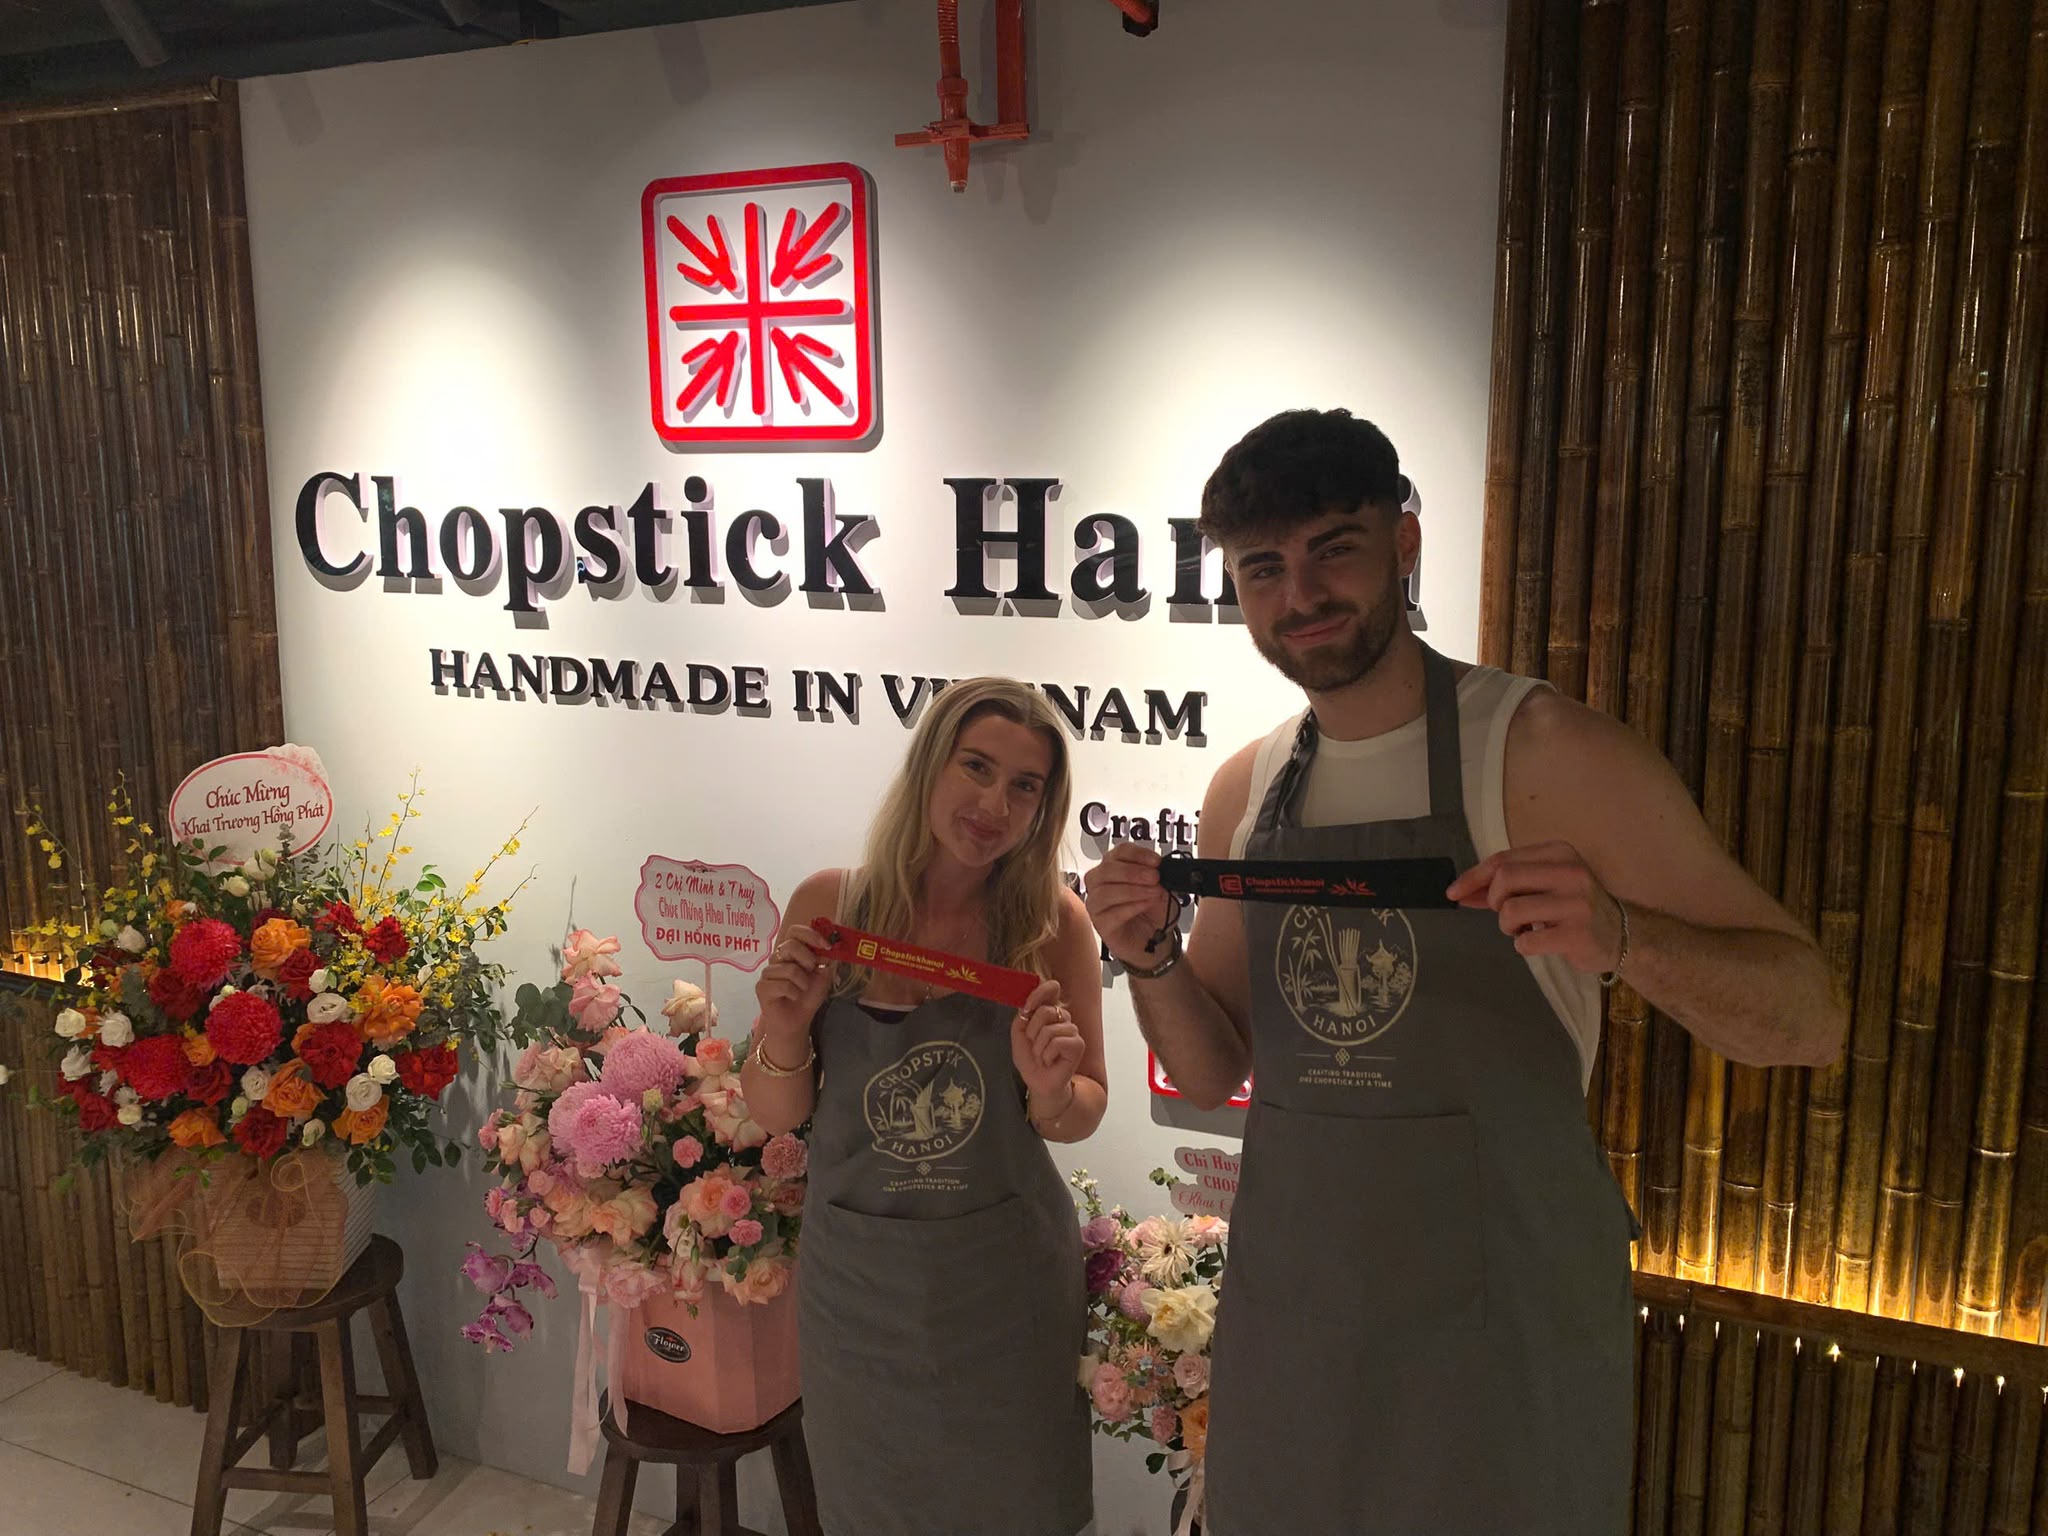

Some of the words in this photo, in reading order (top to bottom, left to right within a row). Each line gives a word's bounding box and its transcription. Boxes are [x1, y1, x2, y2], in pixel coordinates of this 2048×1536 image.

[295, 471, 881, 612] Chopstick
[429, 648, 769, 709] HANDMADE
[793, 669, 860, 716] IN
[880, 673, 1207, 738] VNAM
[205, 785, 241, 809] Chúc
[243, 779, 290, 808] Mừng
[181, 816, 211, 836] Khai
[212, 812, 260, 834] Trương
[262, 805, 294, 829] Hồng
[295, 800, 325, 820] Phát
[655, 873, 663, 889] 2
[686, 875, 714, 896] Minh
[718, 882, 725, 897] &
[656, 927, 680, 945] ĐẠI
[725, 935, 760, 953] PHÁT
[1313, 1014, 1377, 1036] HANOI
[1342, 1069, 1382, 1079] TRADITION
[891, 1134, 953, 1155] HANOI
